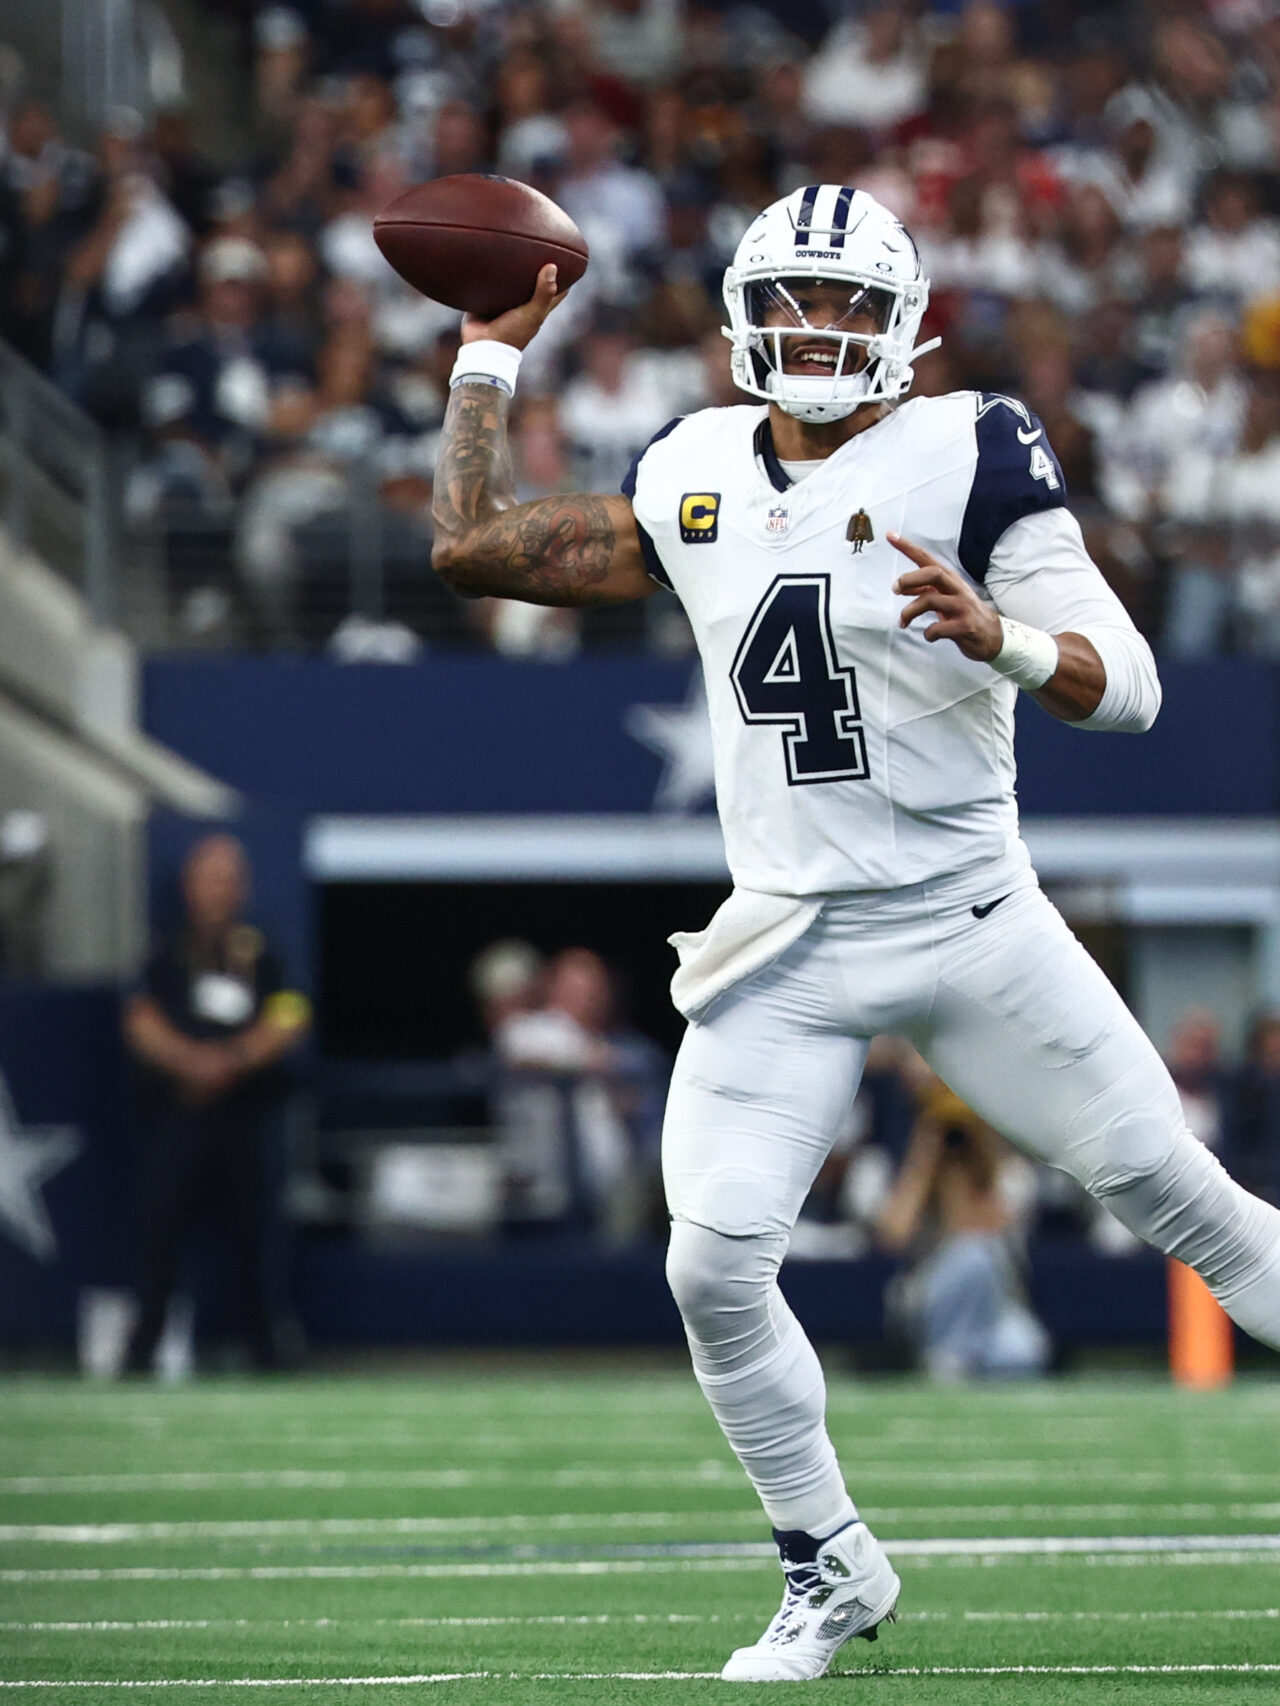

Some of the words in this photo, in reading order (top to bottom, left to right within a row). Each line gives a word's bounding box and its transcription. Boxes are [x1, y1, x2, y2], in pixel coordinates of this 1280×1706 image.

[795, 250, 841, 260] COWBOYS
[1029, 445, 1060, 490] 4
[682, 495, 717, 530] C
[729, 573, 870, 786] 4
